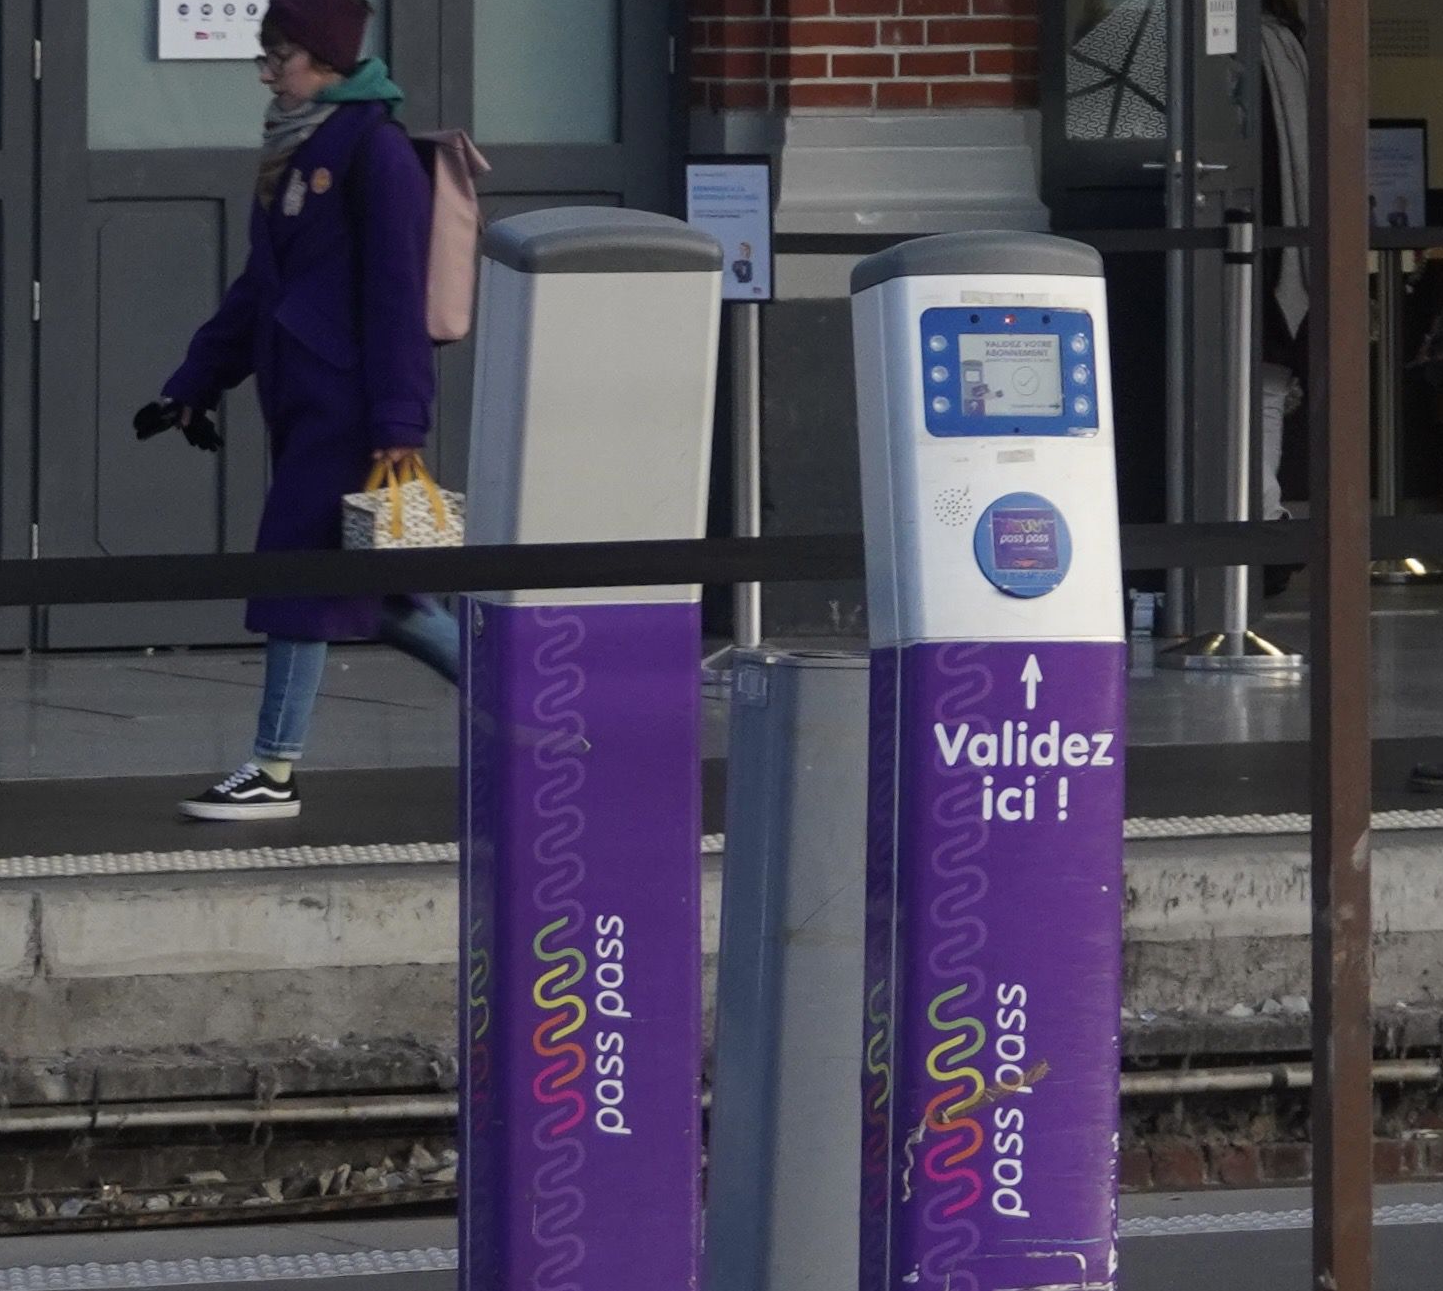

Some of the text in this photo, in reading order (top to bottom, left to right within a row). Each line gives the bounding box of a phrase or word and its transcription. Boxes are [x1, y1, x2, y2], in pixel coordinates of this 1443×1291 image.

[985, 340, 1021, 348] VALIDEZ
[985, 349, 1049, 357] ABONNEMENT
[933, 722, 1115, 767] Validez
[982, 776, 1069, 823] ici !
[595, 913, 633, 1136] pass pass
[990, 981, 1032, 1219] pass pass
